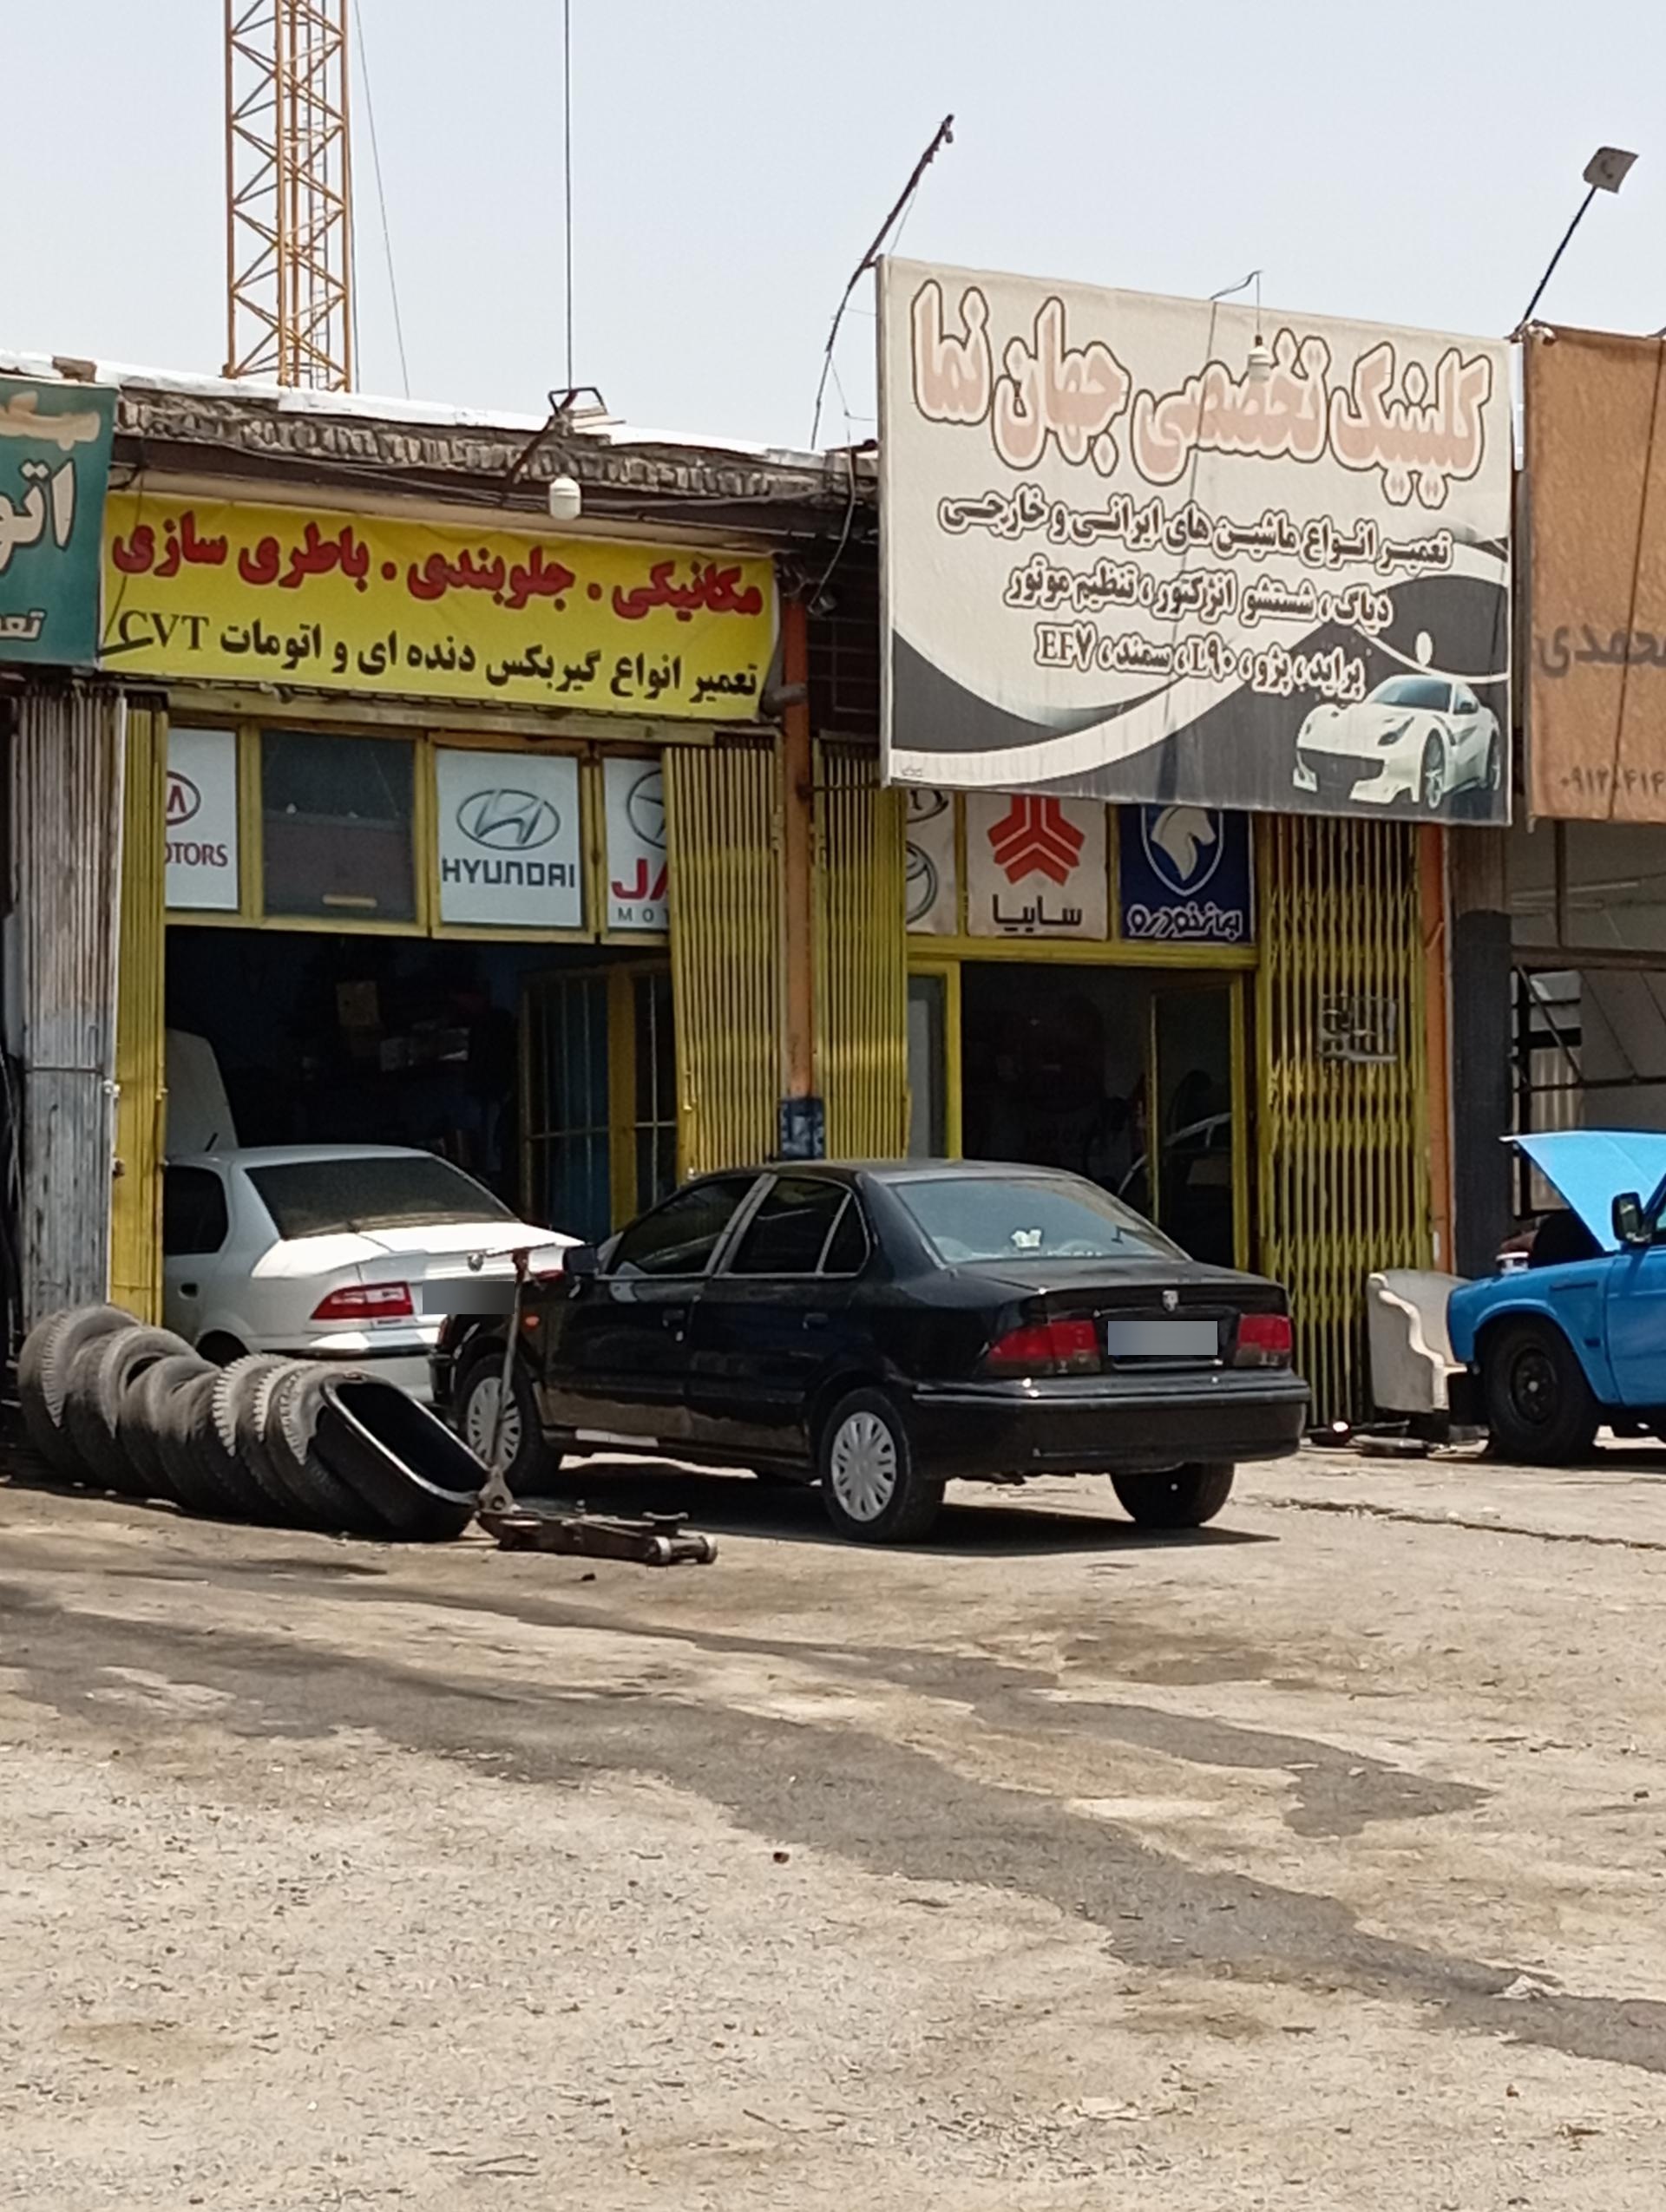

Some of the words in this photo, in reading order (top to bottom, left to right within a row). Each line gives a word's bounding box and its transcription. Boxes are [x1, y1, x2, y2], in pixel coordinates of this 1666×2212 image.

[911, 279, 993, 426] نما
[993, 297, 1131, 476] جهان
[1132, 328, 1330, 485] تخصصی
[1328, 341, 1492, 507] کلینیک
[943, 488, 1046, 533] خارجی
[1050, 507, 1068, 539] و
[1072, 499, 1160, 545] ایرانی
[1164, 506, 1210, 548] های
[112, 510, 228, 578] سازی
[239, 521, 370, 592] باطری
[1215, 516, 1298, 553] ماشین
[1303, 521, 1375, 566] انواع
[1378, 533, 1451, 572] تعمیر
[408, 546, 575, 611] جلوبندی
[613, 560, 764, 622] مکانیکی
[1007, 559, 1071, 601] موتور
[1075, 563, 1136, 605] تنظیم
[119, 610, 209, 651] CVT
[220, 619, 321, 670] اتومات
[331, 640, 347, 673] و
[358, 631, 397, 676] ای
[407, 636, 476, 672] دنده
[486, 645, 601, 692] گیربکس
[610, 653, 681, 700] انواع
[689, 664, 758, 704] تعمیر
[165, 841, 227, 867] TORS
[442, 856, 575, 888] HYUNDAI
[992, 893, 1082, 933] سایپا
